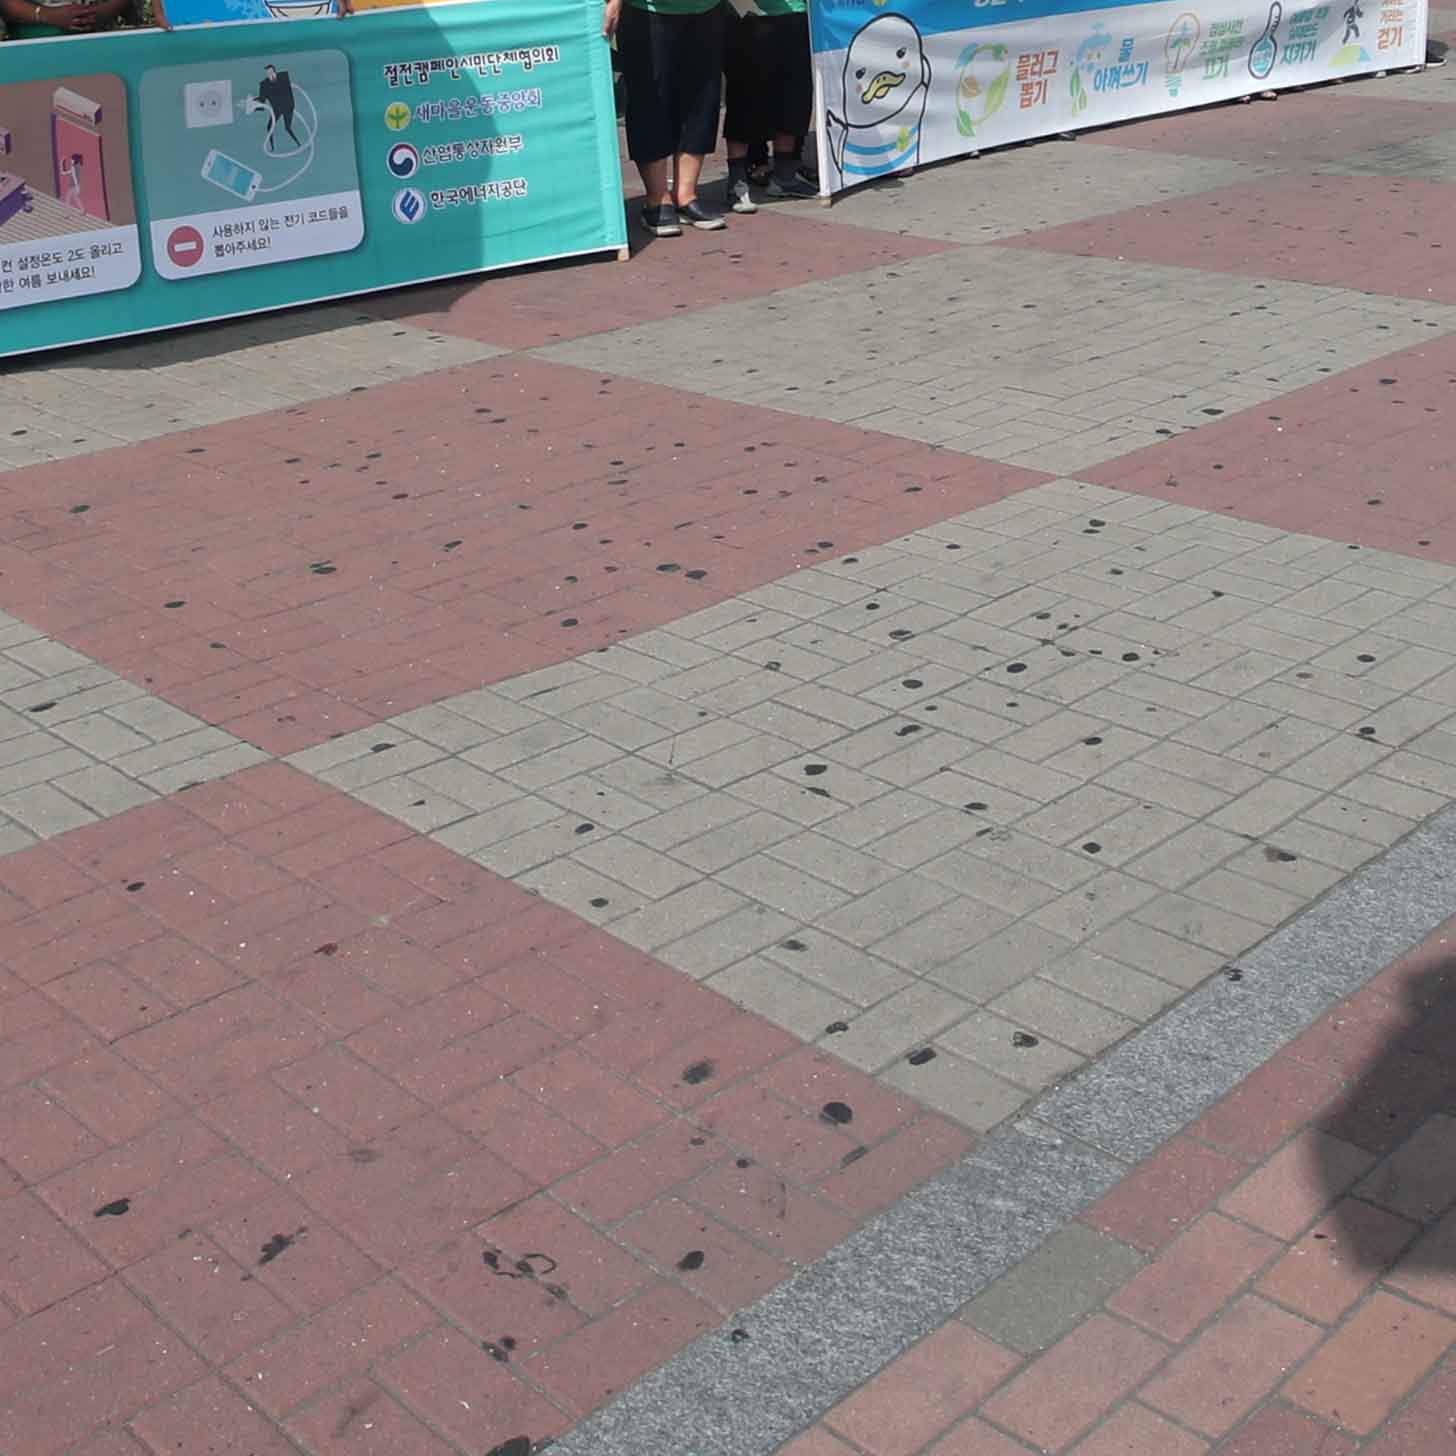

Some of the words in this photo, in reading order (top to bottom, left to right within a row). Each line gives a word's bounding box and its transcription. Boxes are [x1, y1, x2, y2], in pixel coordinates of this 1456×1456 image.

[1119, 38, 1134, 62] 물
[1016, 50, 1059, 81] 플러그
[416, 88, 542, 122] 새마을운동중앙회
[1020, 80, 1048, 109] 뽑기
[423, 134, 524, 165] 산업통상자원부
[431, 178, 528, 209] 한국에너지공단
[213, 221, 255, 238] 사용하지
[259, 216, 281, 232] 않는
[284, 212, 305, 228] 전기
[18, 252, 63, 272] 설정온도
[68, 248, 86, 263] 2도
[90, 242, 124, 259] 올리고
[214, 239, 271, 258] 뽑아주세요!
[19, 274, 42, 289] 여름
[47, 267, 95, 286] 보내세요!
